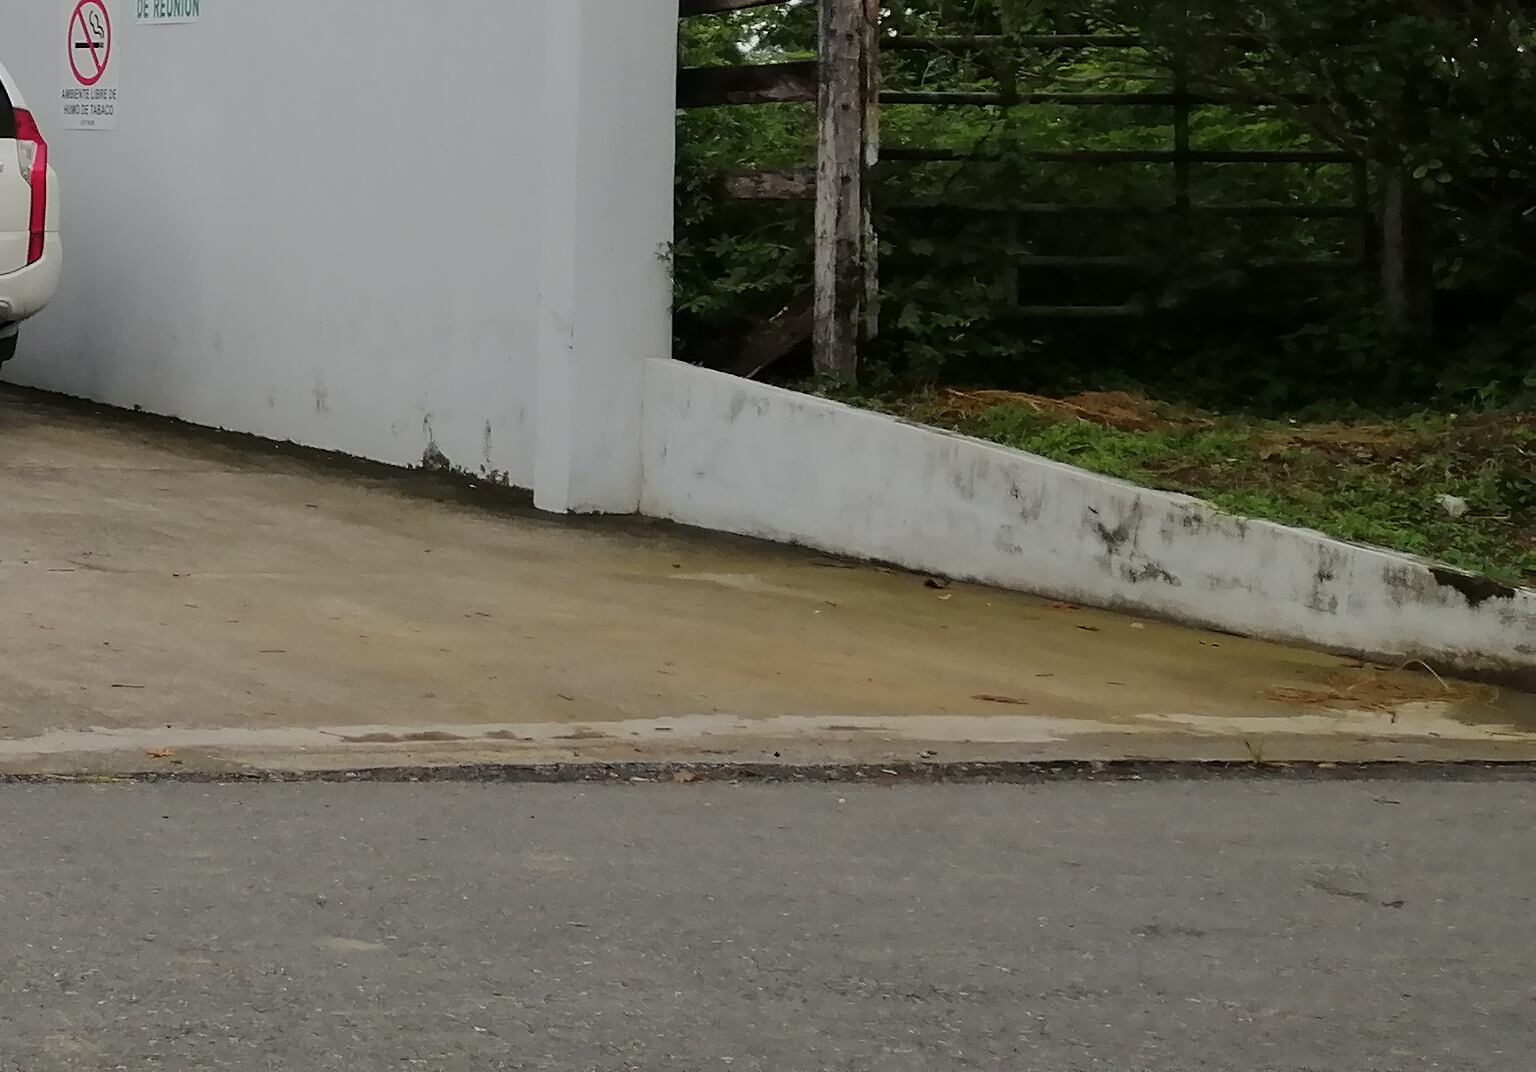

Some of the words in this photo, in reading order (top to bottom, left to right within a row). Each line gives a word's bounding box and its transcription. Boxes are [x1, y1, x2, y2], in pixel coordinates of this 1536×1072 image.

[61, 88, 90, 99] AMBIENTE
[109, 88, 117, 99] DE
[81, 104, 89, 115] DE
[90, 104, 114, 115] TABACO
